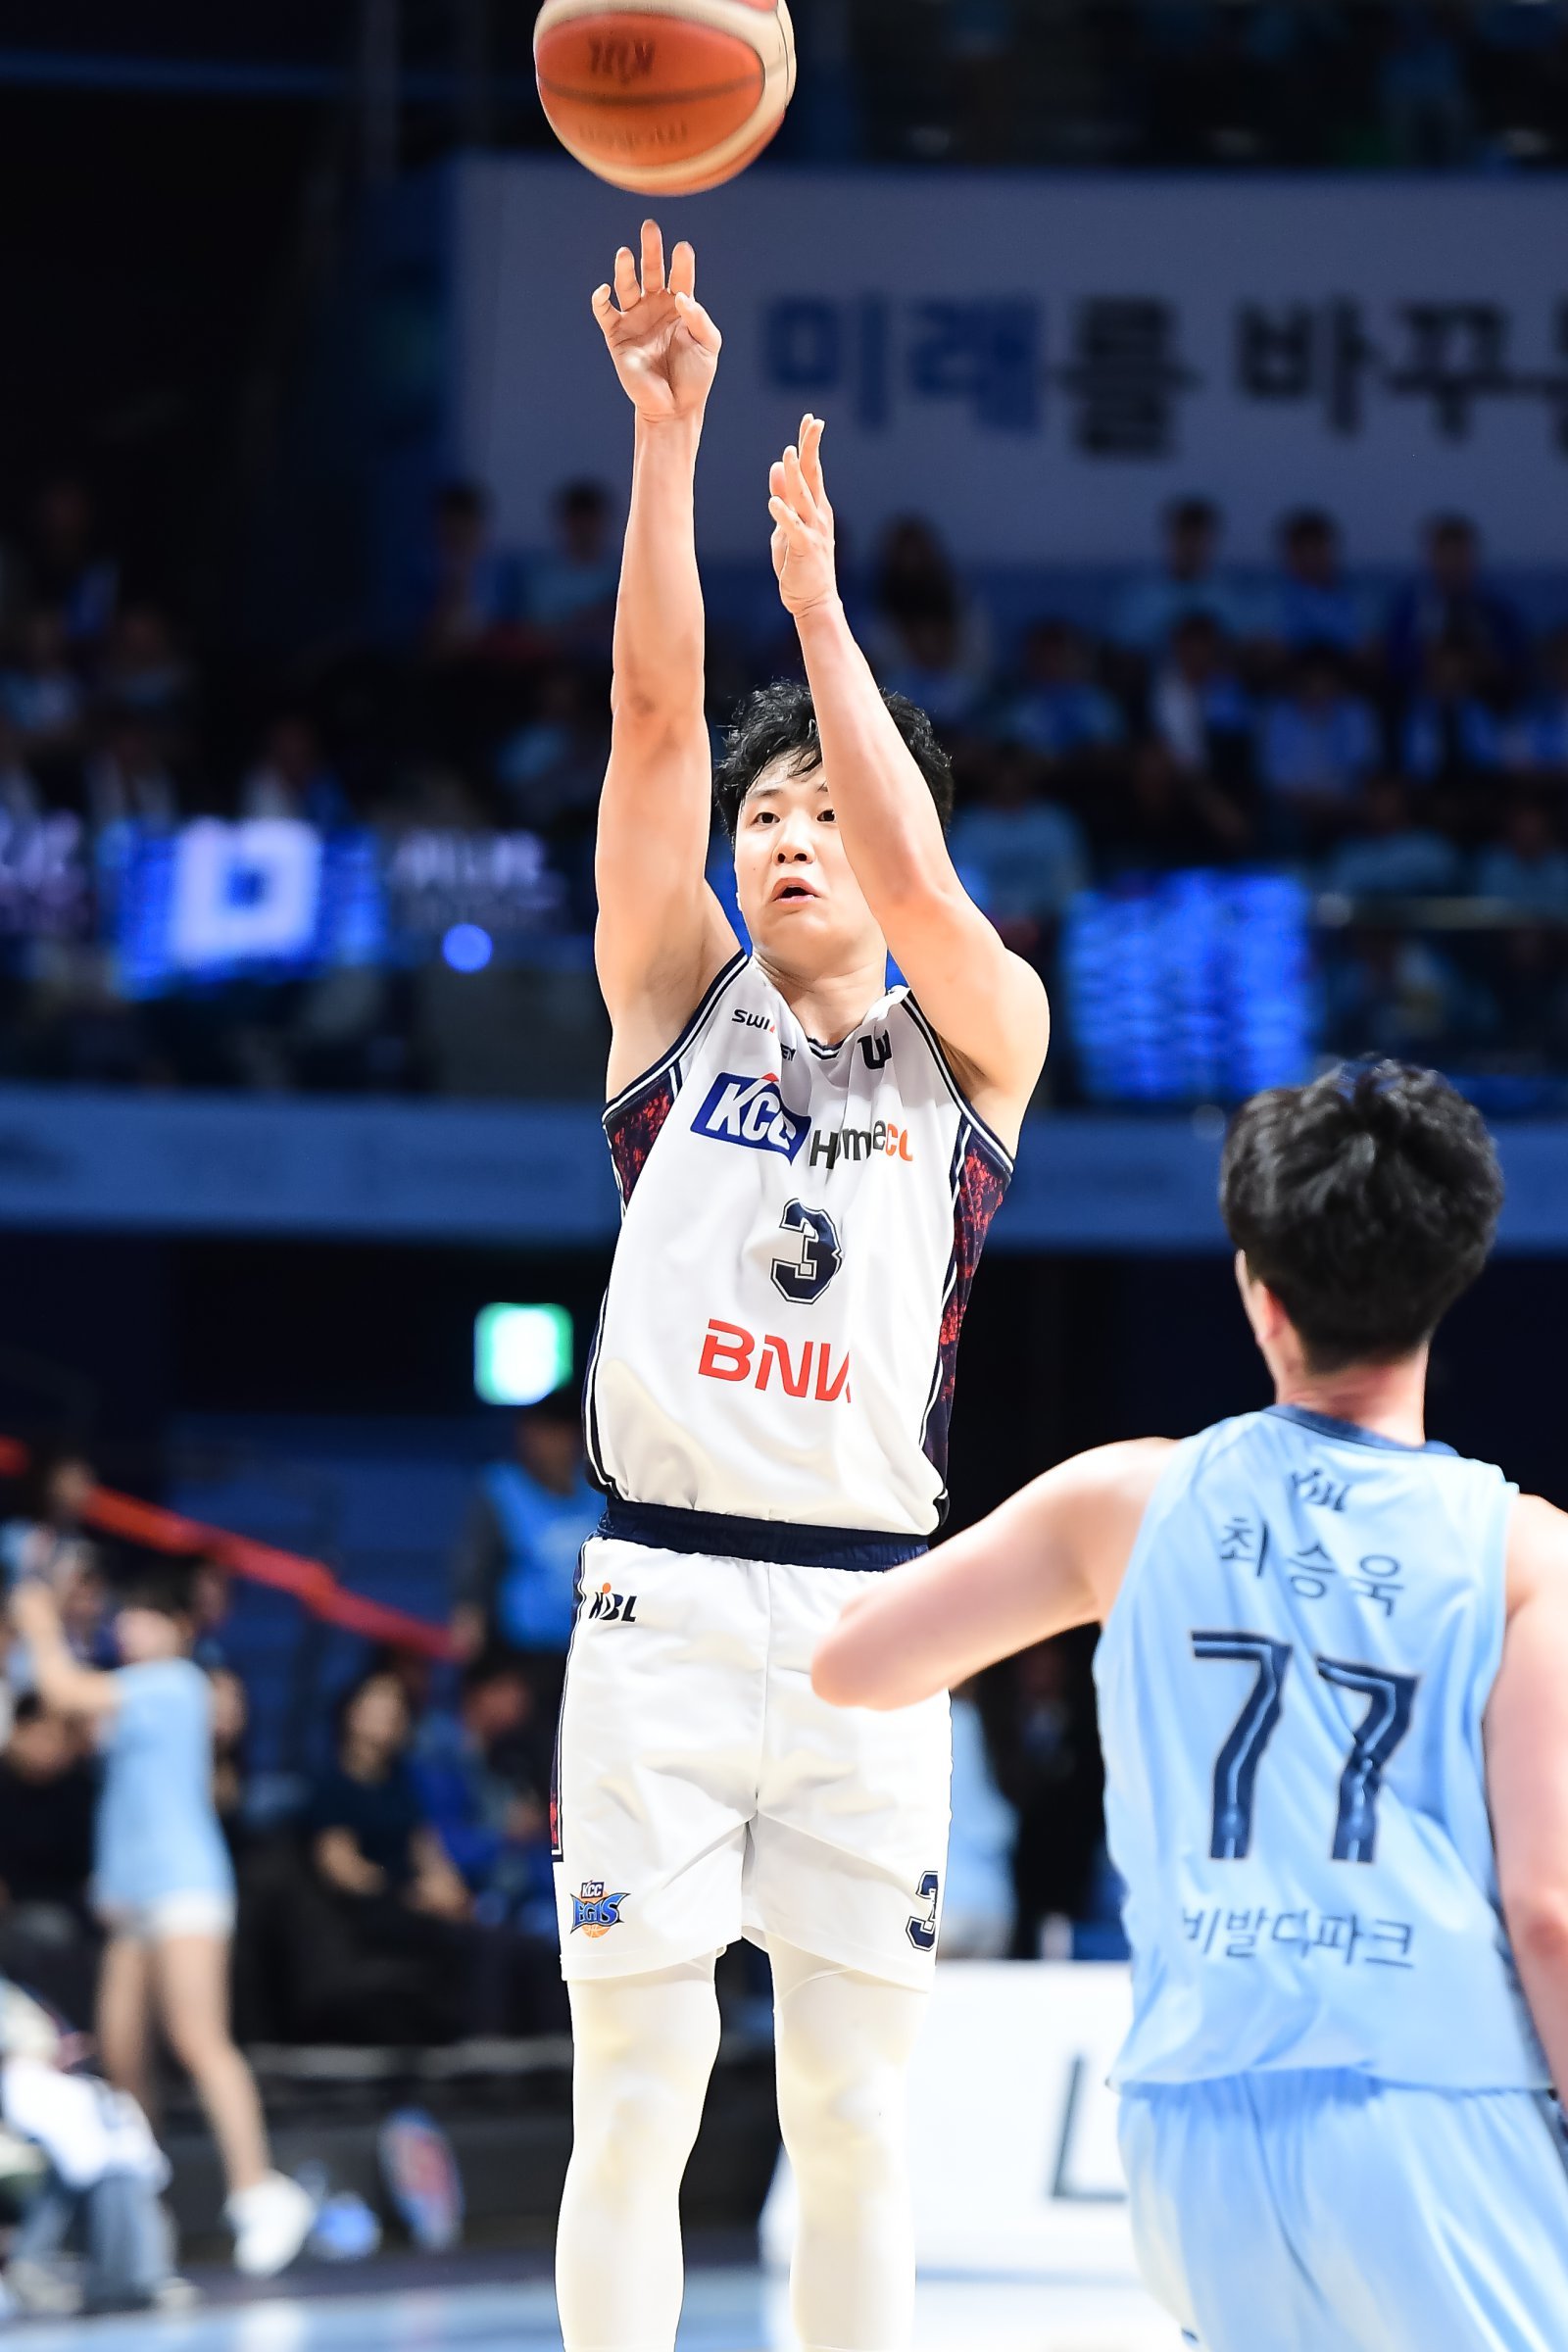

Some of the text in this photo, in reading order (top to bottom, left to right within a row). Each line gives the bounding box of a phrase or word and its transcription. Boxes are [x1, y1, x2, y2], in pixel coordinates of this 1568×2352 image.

[765, 293, 1568, 458] 미래를 바꾸
[770, 1198, 843, 1305] 3
[1219, 1517, 1404, 1617] 최승욱
[1190, 1630, 1420, 1865] 77
[581, 1881, 604, 1898] KCC
[1180, 1906, 1415, 1970] 비발디파크
